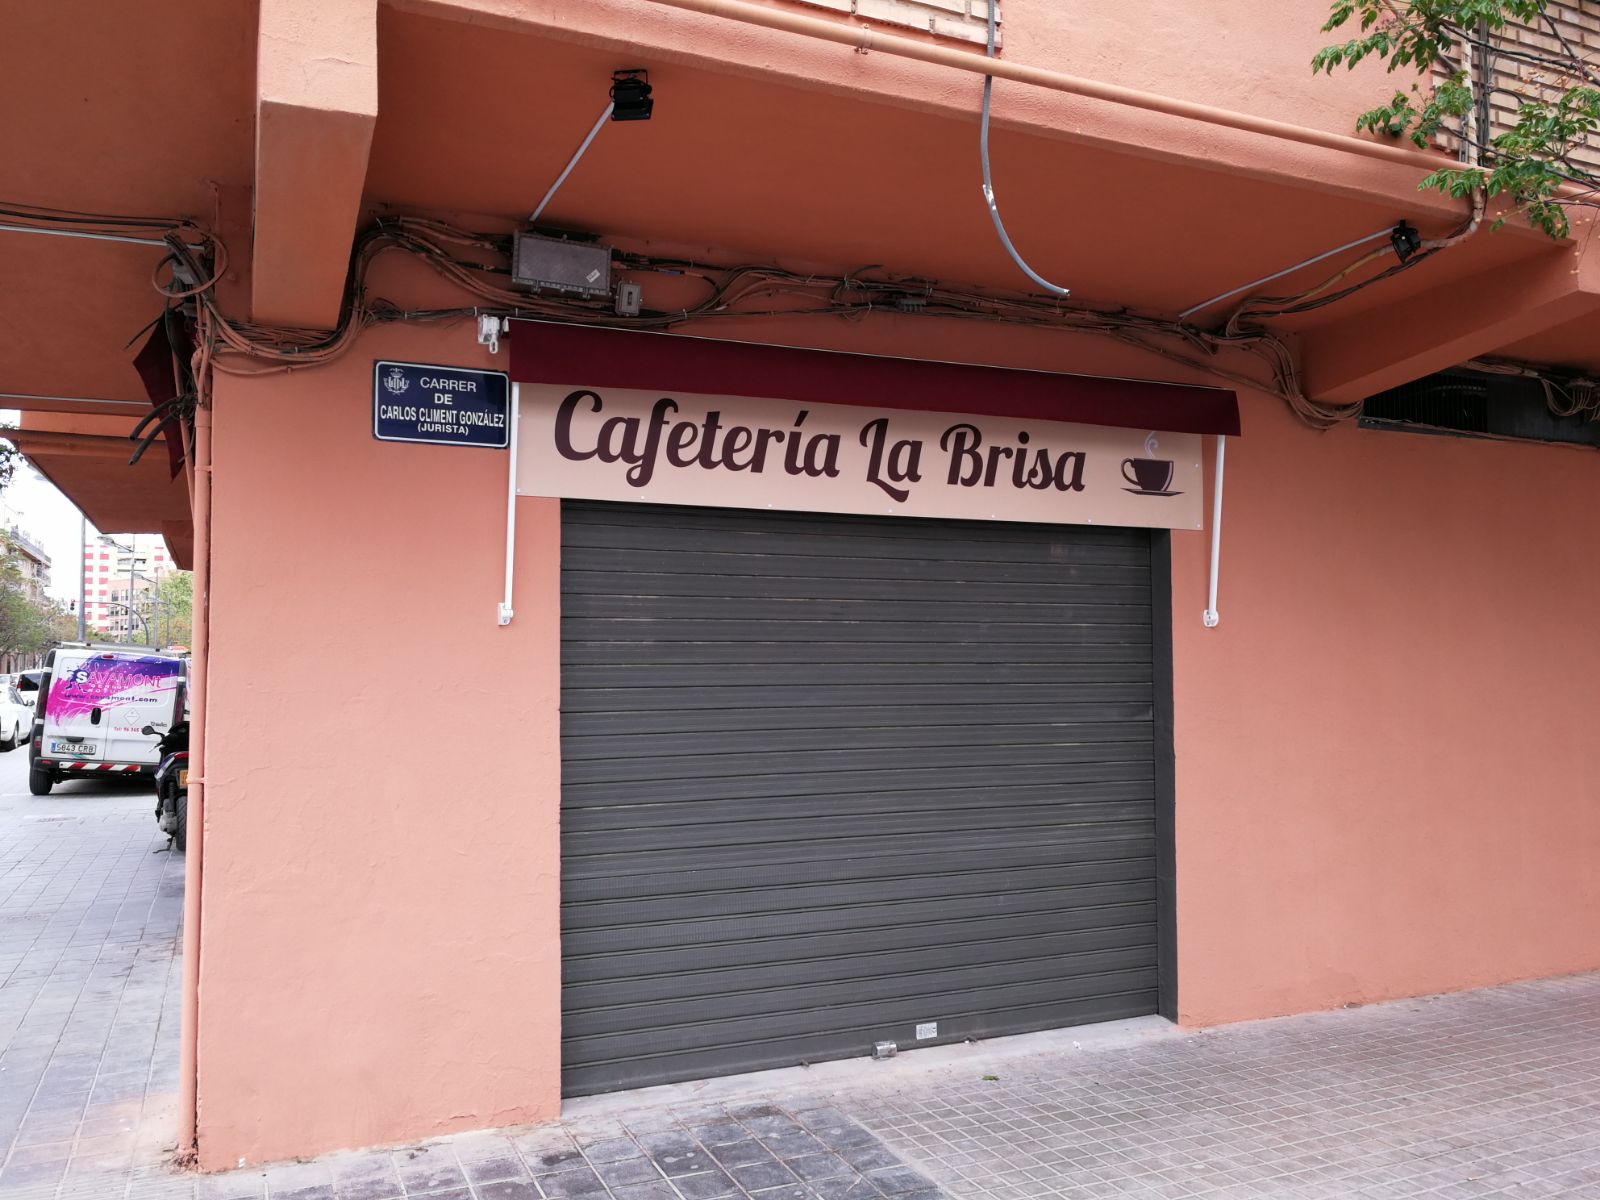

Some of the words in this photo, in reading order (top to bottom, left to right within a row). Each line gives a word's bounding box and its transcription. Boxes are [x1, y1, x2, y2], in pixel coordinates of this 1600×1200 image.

[420, 377, 477, 392] CARRER
[434, 393, 453, 405] DE
[380, 405, 416, 421] CARLOS
[419, 407, 457, 424] CLIMENT
[459, 409, 504, 427] GONZÁLEZ
[417, 423, 469, 436] (JURISTA)
[554, 389, 841, 488] Cafetería
[858, 417, 923, 503] La
[939, 423, 1086, 492] Brisa
